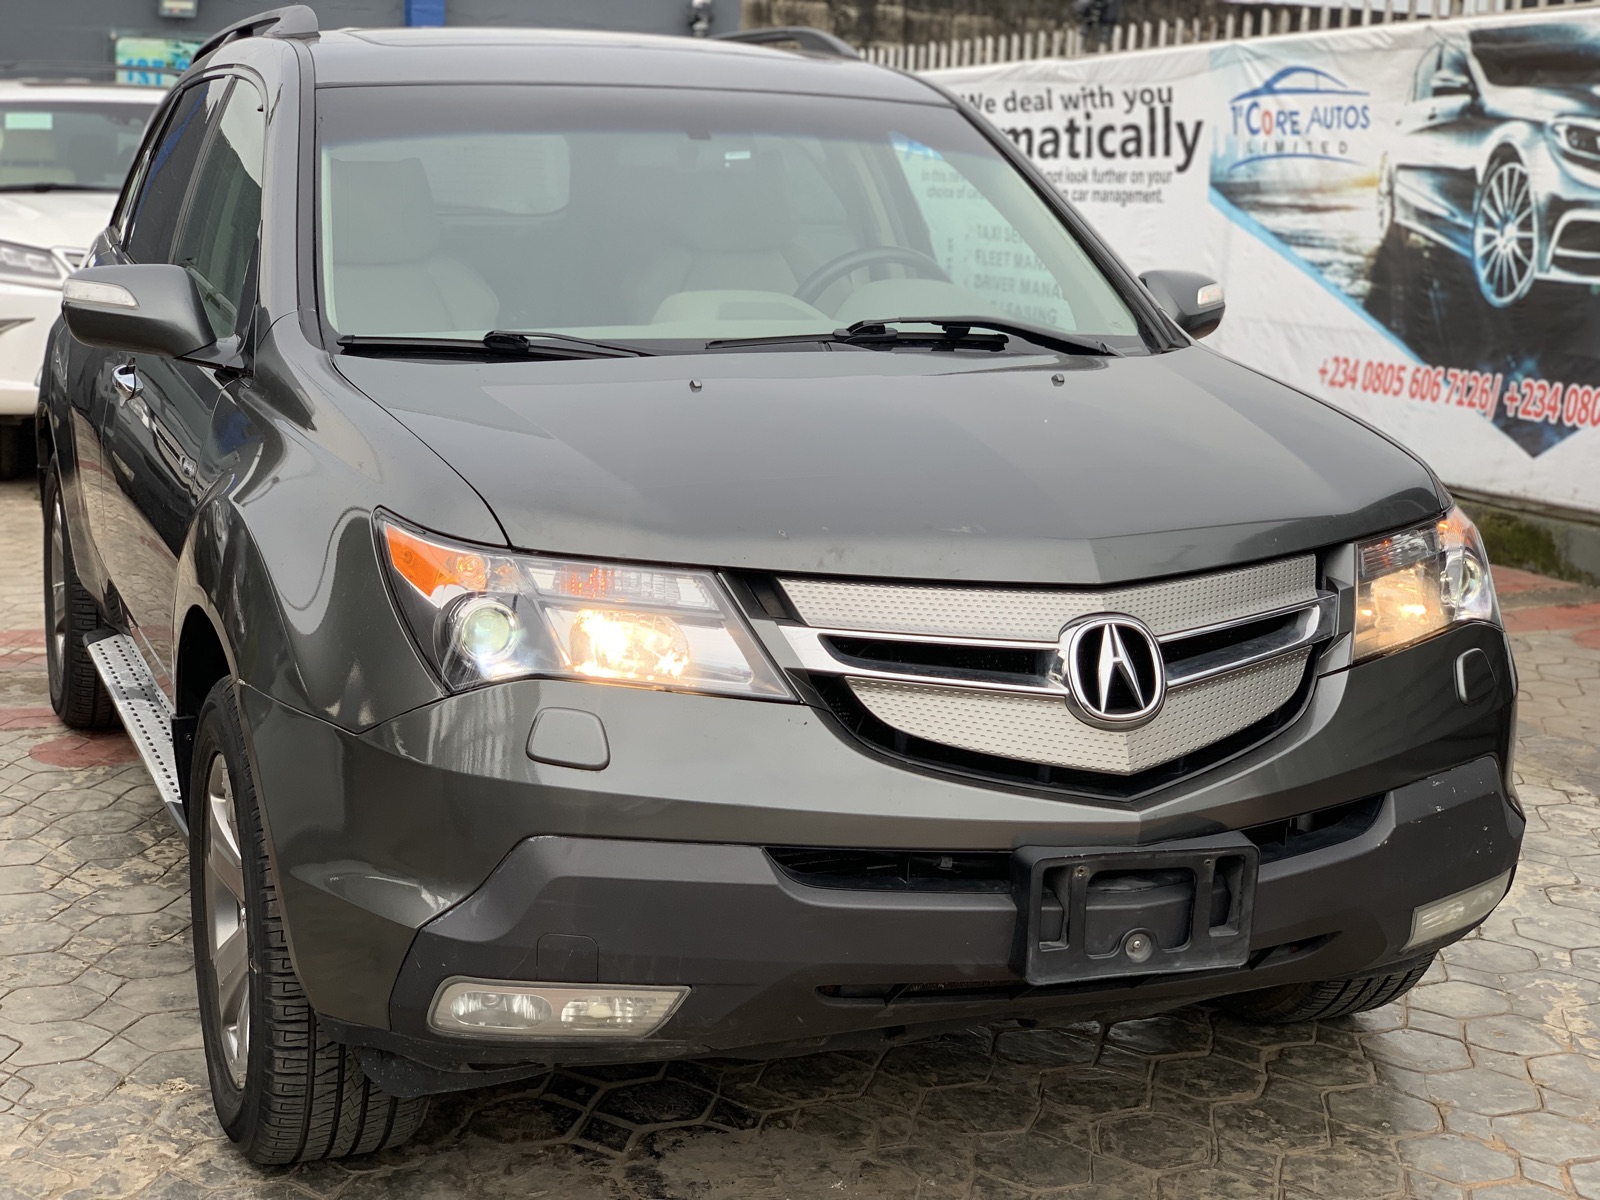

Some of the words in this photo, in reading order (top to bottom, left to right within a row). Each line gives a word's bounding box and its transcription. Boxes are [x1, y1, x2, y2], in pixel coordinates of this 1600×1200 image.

[1003, 88, 1053, 113] deal
[1060, 84, 1115, 111] with
[1123, 86, 1174, 114] you
[1305, 105, 1370, 136] AUTOS
[1247, 140, 1349, 155] LIMITED
[1065, 167, 1088, 184] look
[1092, 167, 1128, 184] further
[1129, 171, 1145, 184] on
[1147, 171, 1173, 187] your
[1071, 189, 1089, 202] car
[974, 248, 1011, 268] FLEET
[973, 272, 1016, 293] DRIVER
[1317, 355, 1360, 390] +234
[1361, 360, 1407, 397] 0805
[1409, 366, 1444, 403] 606
[1505, 379, 1562, 421] +234
